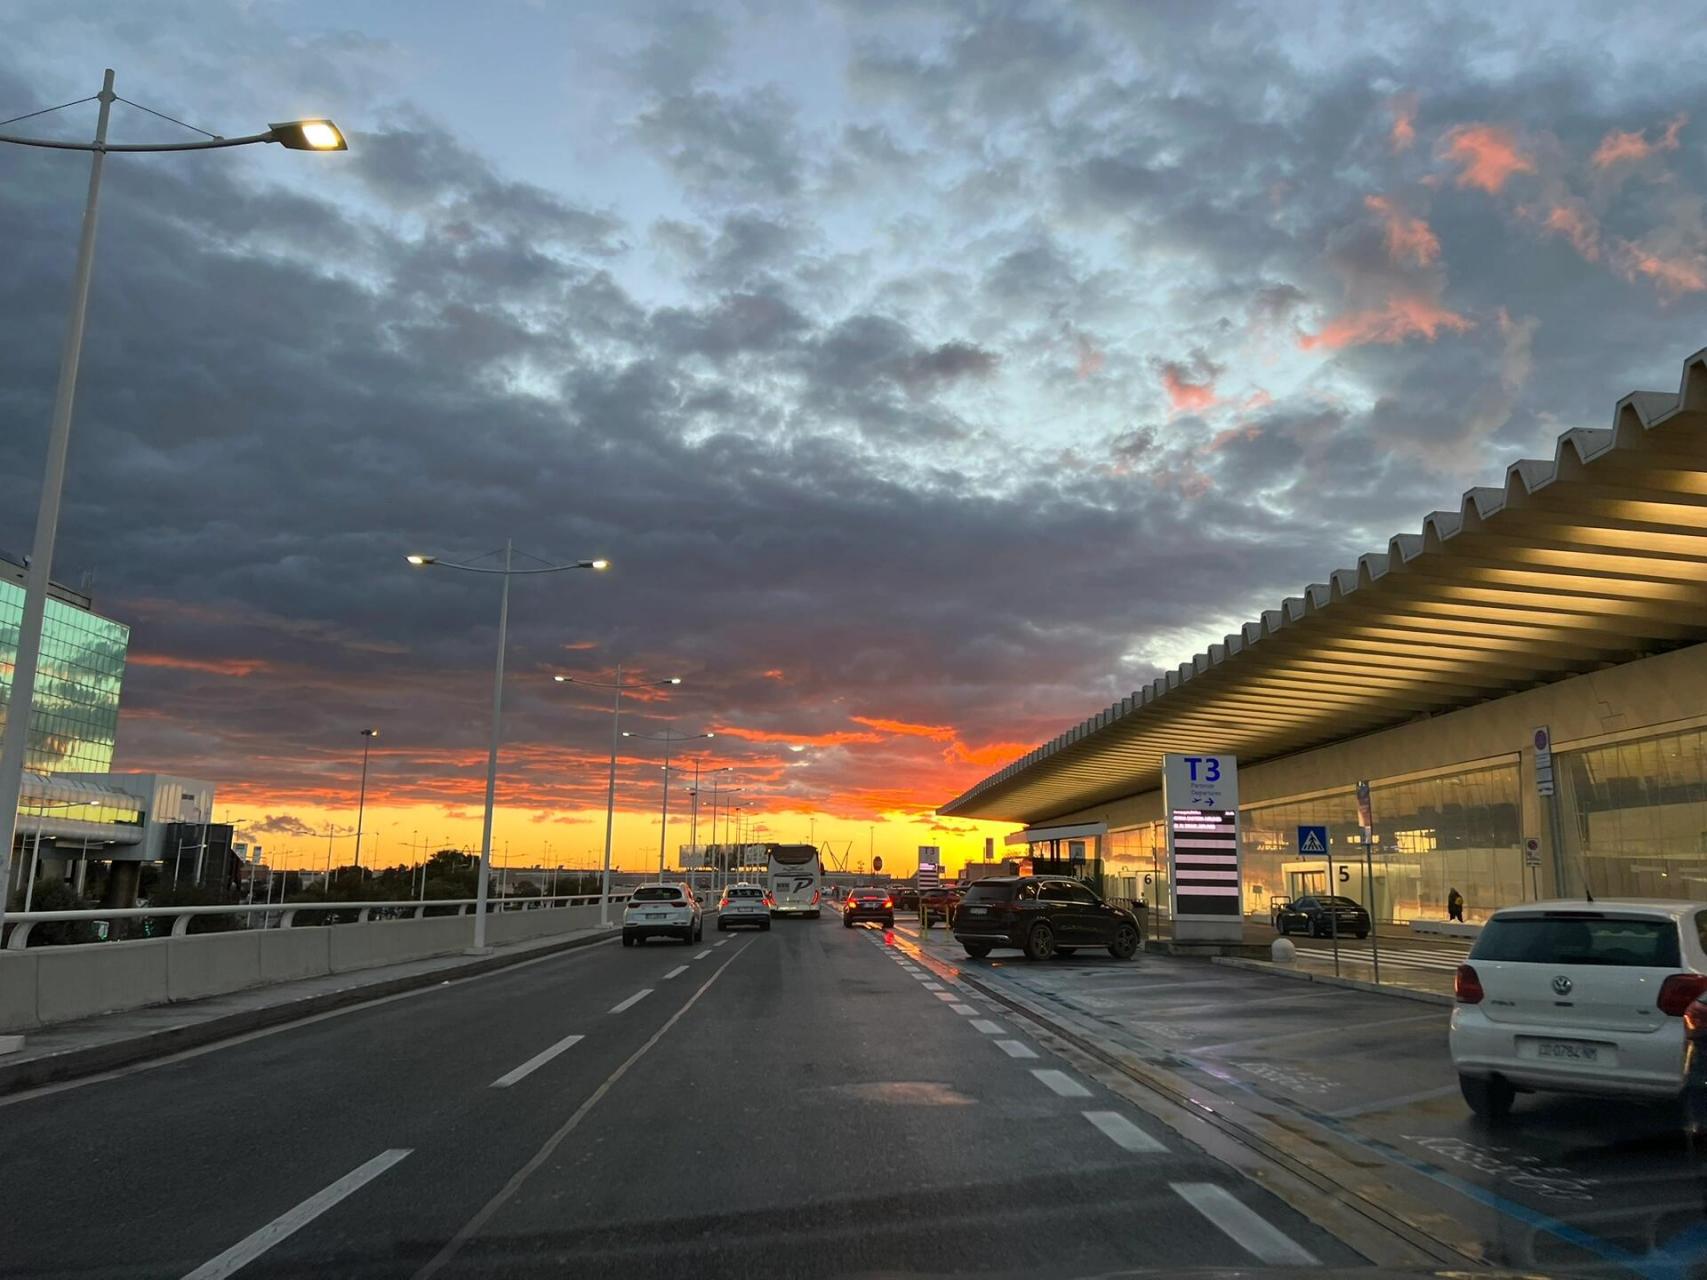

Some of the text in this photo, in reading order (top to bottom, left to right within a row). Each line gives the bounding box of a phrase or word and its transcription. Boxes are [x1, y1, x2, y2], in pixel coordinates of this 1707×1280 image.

[1184, 757, 1221, 782] T3
[1144, 874, 1152, 885] 6
[1339, 865, 1350, 882] 5
